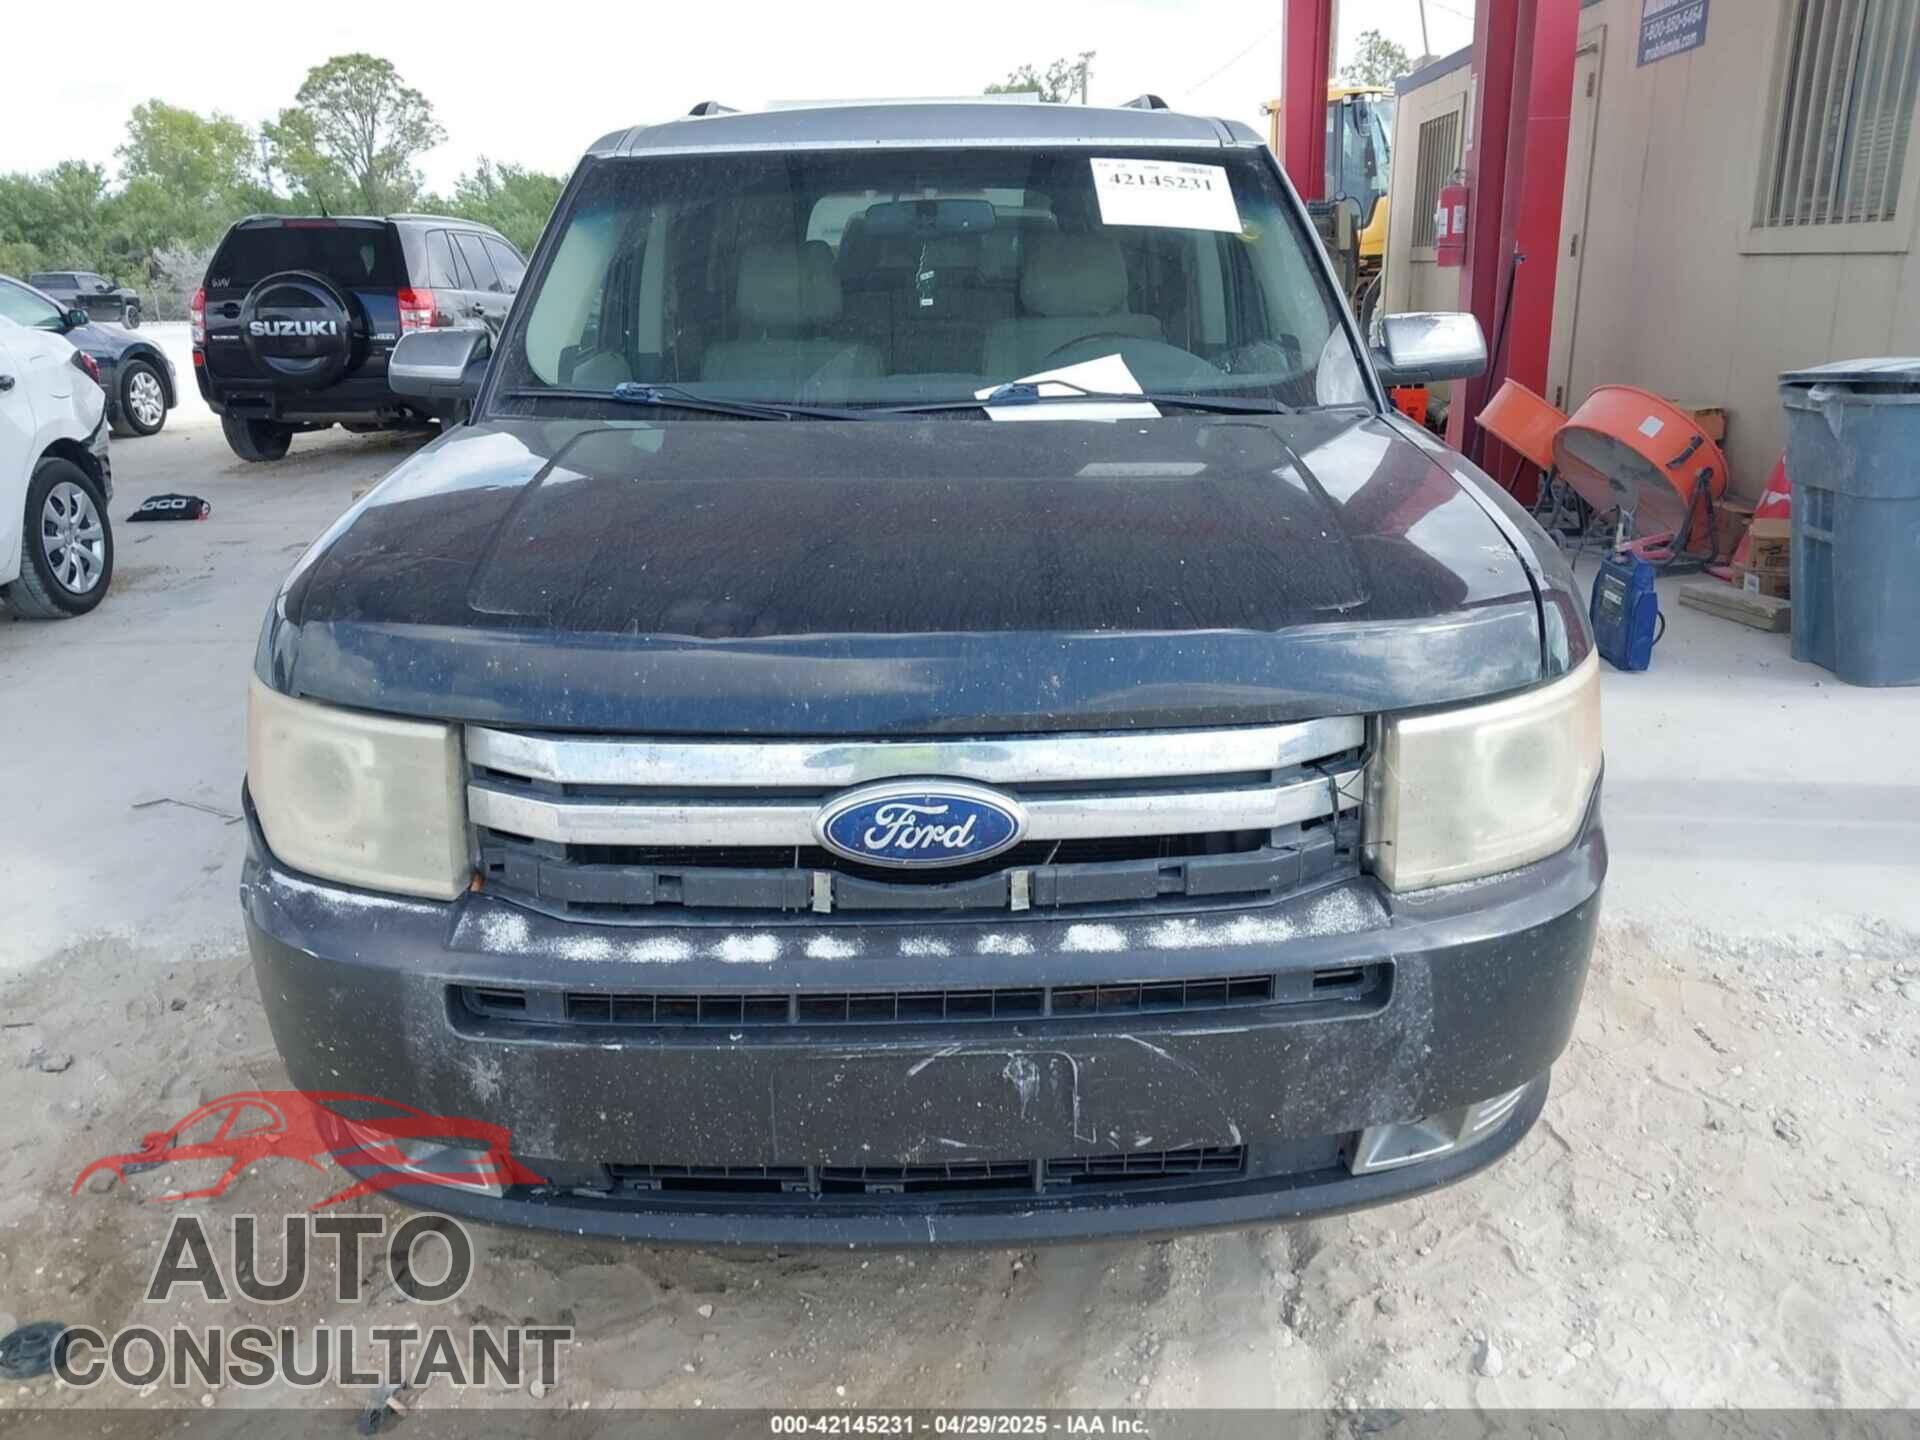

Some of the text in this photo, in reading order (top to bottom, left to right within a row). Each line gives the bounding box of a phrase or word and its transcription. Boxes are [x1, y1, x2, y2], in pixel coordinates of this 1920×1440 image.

[1108, 172, 1212, 192] 42145231
[249, 320, 337, 337] SUZUKI
[863, 803, 977, 850] Ford
